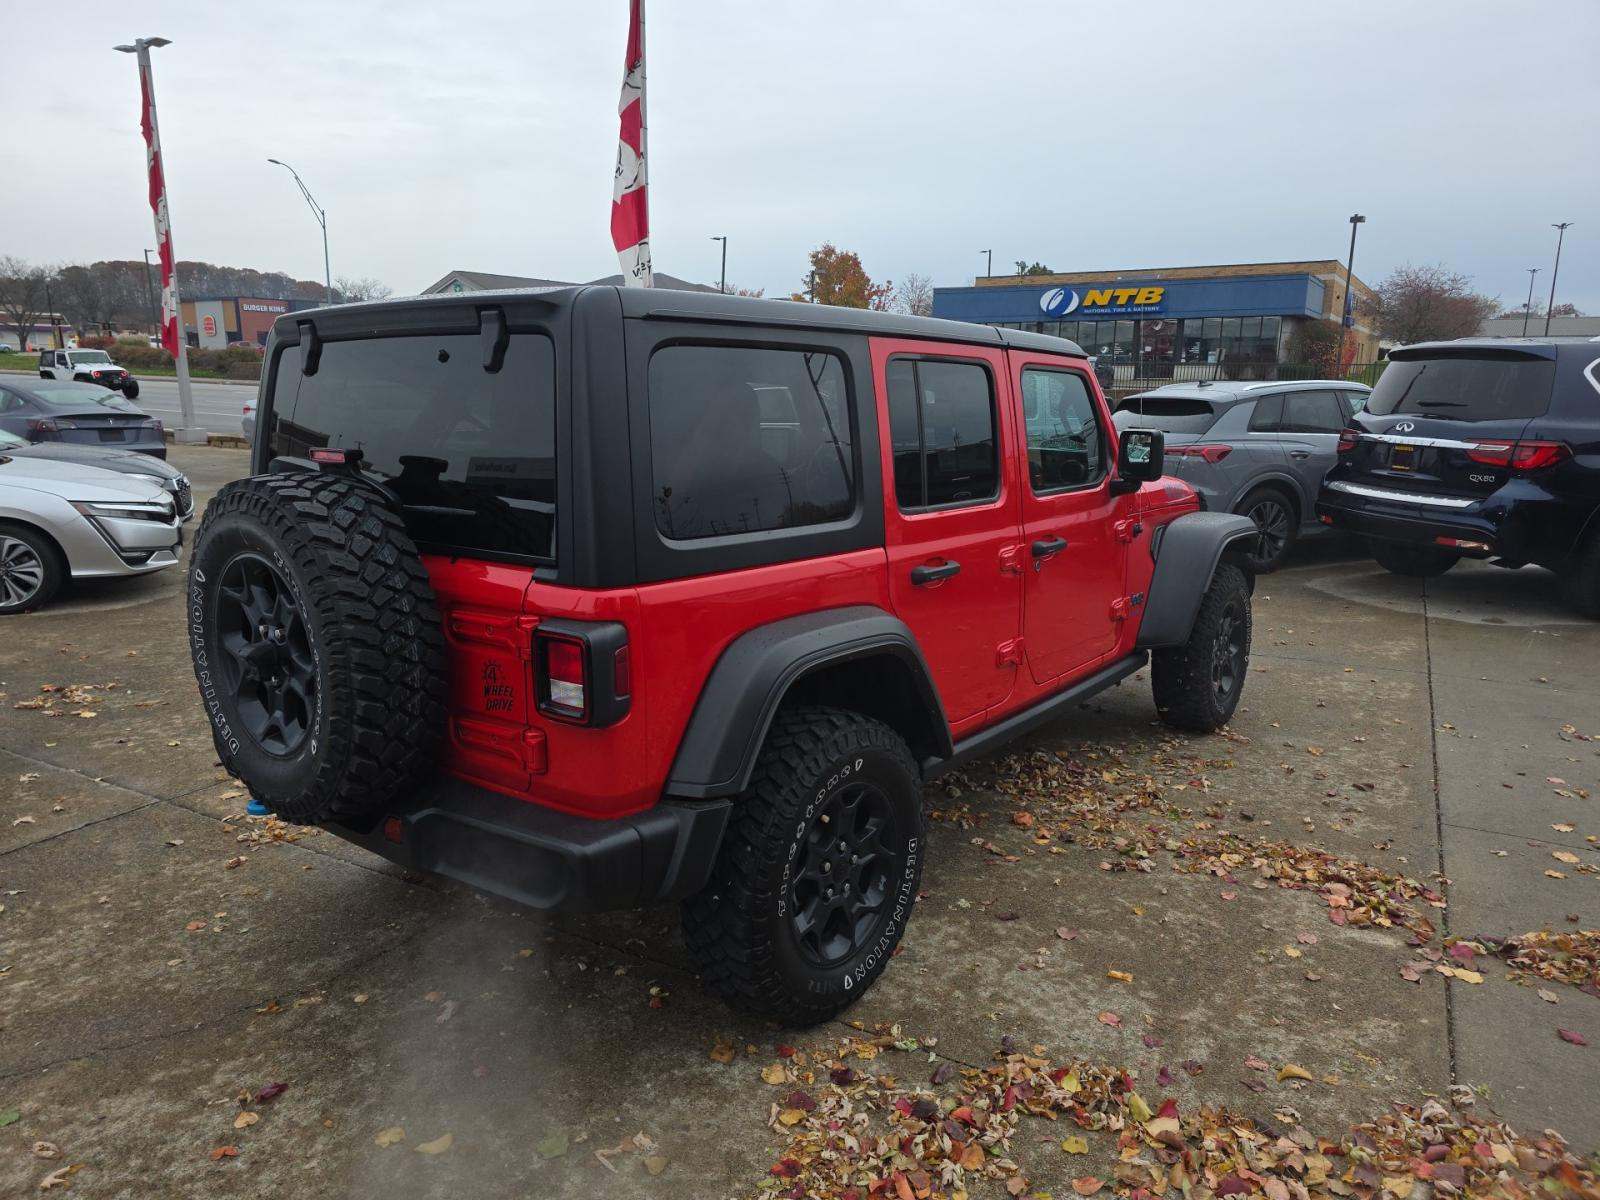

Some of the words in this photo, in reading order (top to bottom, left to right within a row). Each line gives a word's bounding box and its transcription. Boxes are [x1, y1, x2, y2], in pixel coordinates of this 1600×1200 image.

[1082, 287, 1165, 306] NTB
[243, 304, 268, 312] BURGER
[269, 305, 286, 313] KING
[191, 586, 240, 756] DESTINATION
[484, 685, 513, 698] WHEEL
[487, 699, 513, 711] DRIVE
[855, 838, 917, 982] DESTINATION
